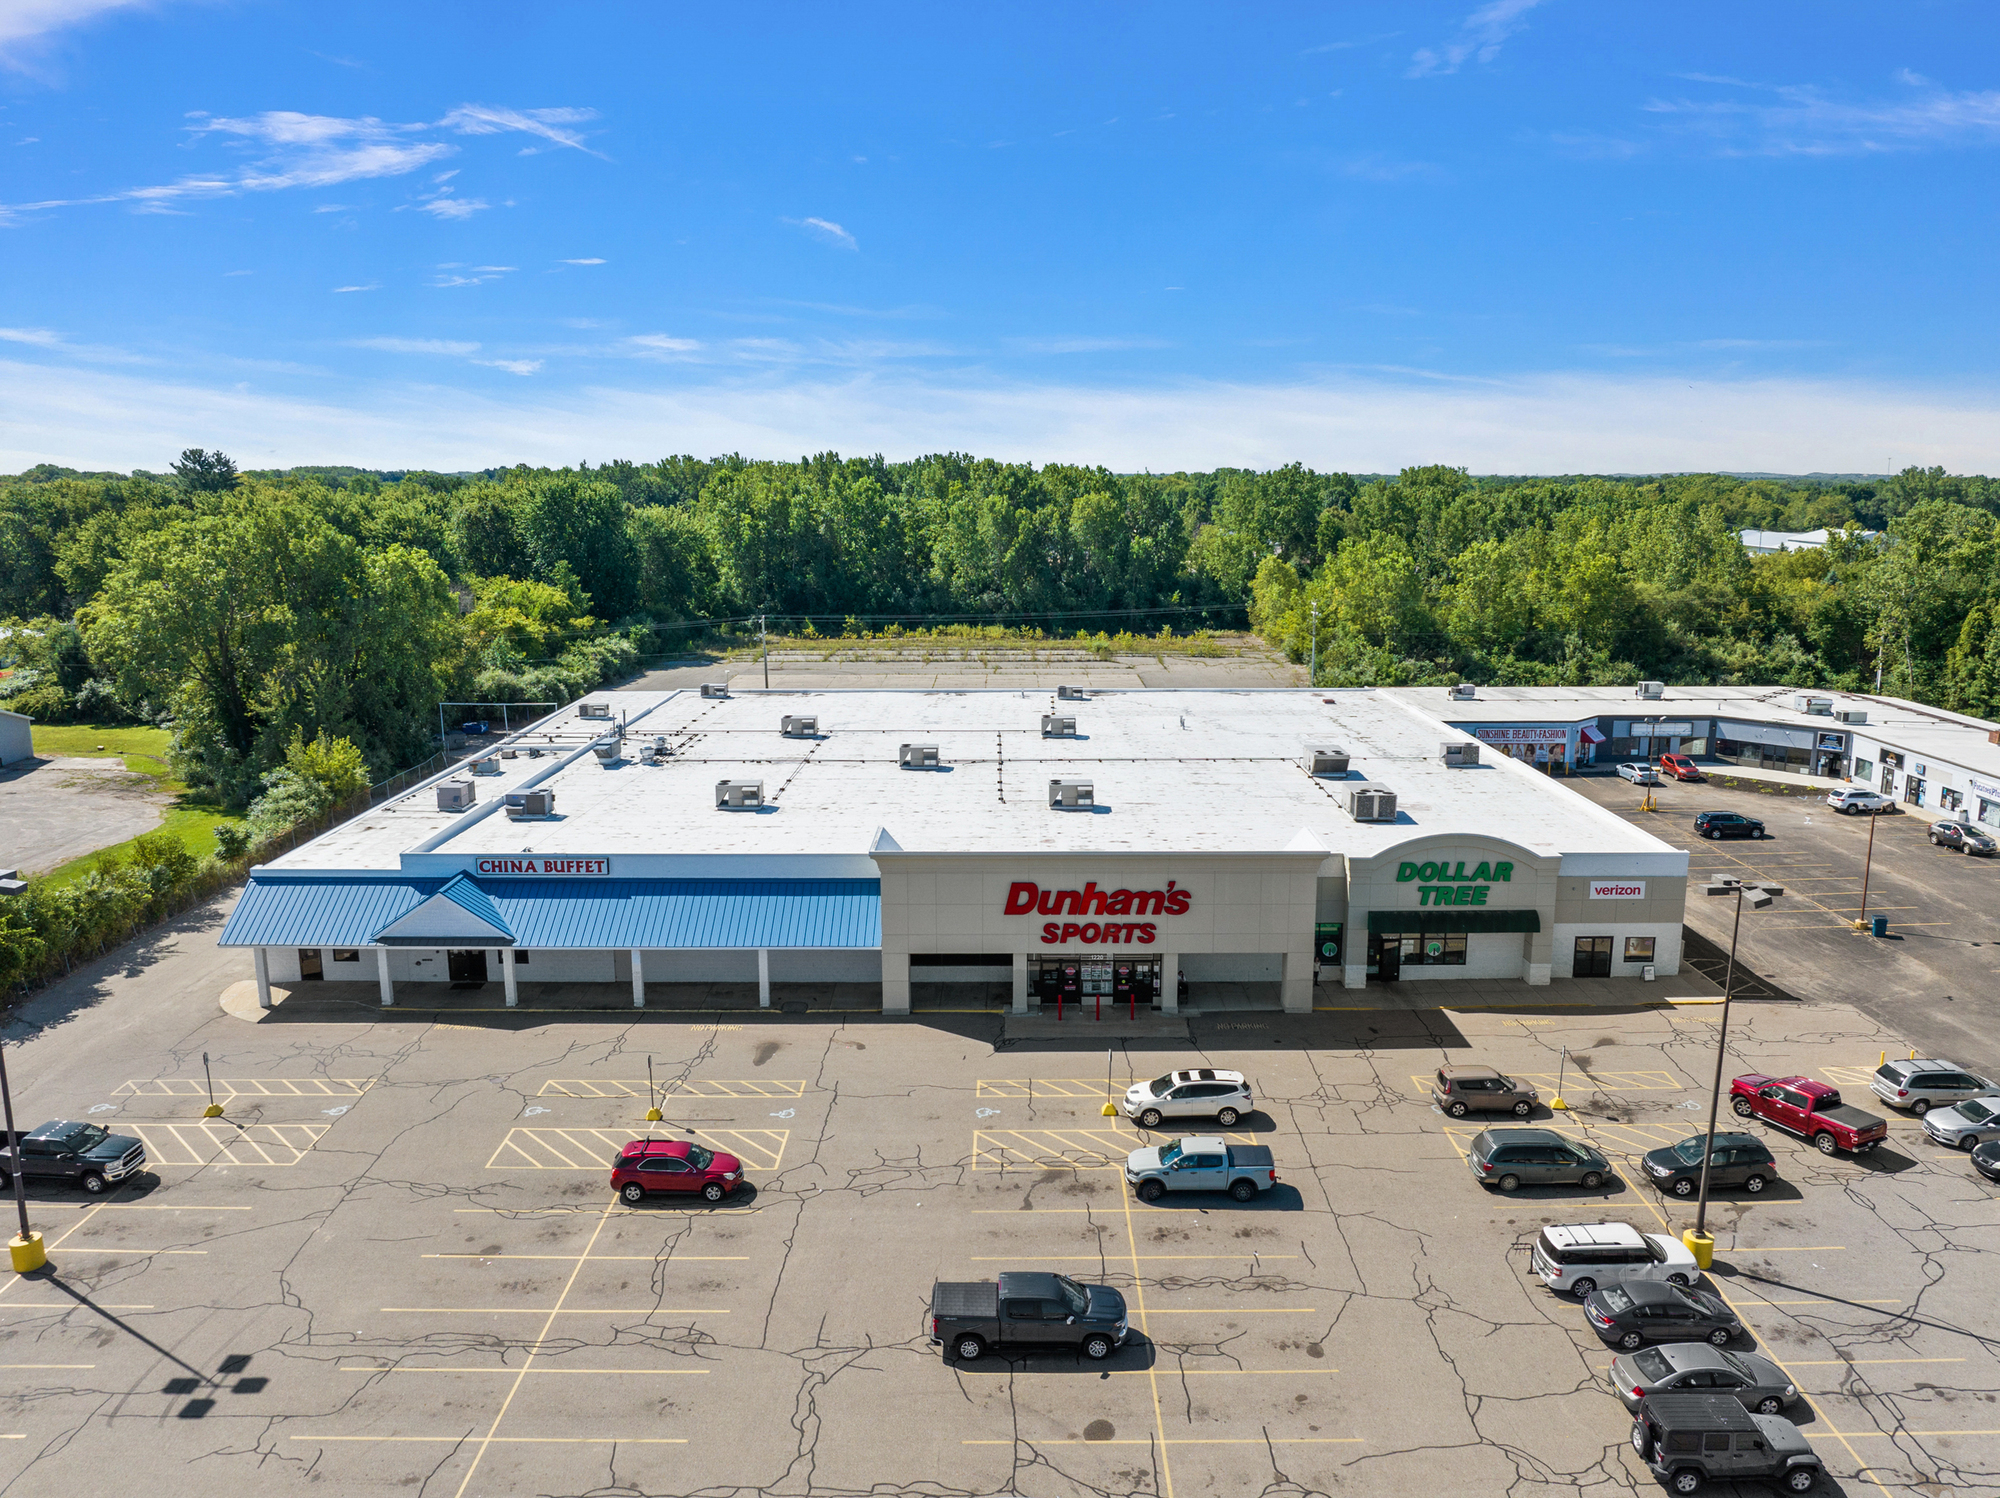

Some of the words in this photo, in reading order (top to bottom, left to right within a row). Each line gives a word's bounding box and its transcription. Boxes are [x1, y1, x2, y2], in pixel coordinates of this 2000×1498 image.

[1477, 729, 1511, 739] SUNSHINE
[1512, 729, 1537, 739] BEAUTY
[1539, 729, 1566, 738] FASHION
[479, 860, 538, 873] CHINA
[543, 860, 605, 873] BUFFET
[1396, 861, 1514, 882] DOLLAR
[1418, 885, 1491, 906] TREE
[1595, 884, 1641, 896] verizon
[1003, 881, 1192, 915] Dunham's
[1040, 922, 1157, 944] SPORTS
[705, 1024, 744, 1032] PARKING
[1217, 1022, 1230, 1030] NO
[1230, 1022, 1269, 1030] PARKING
